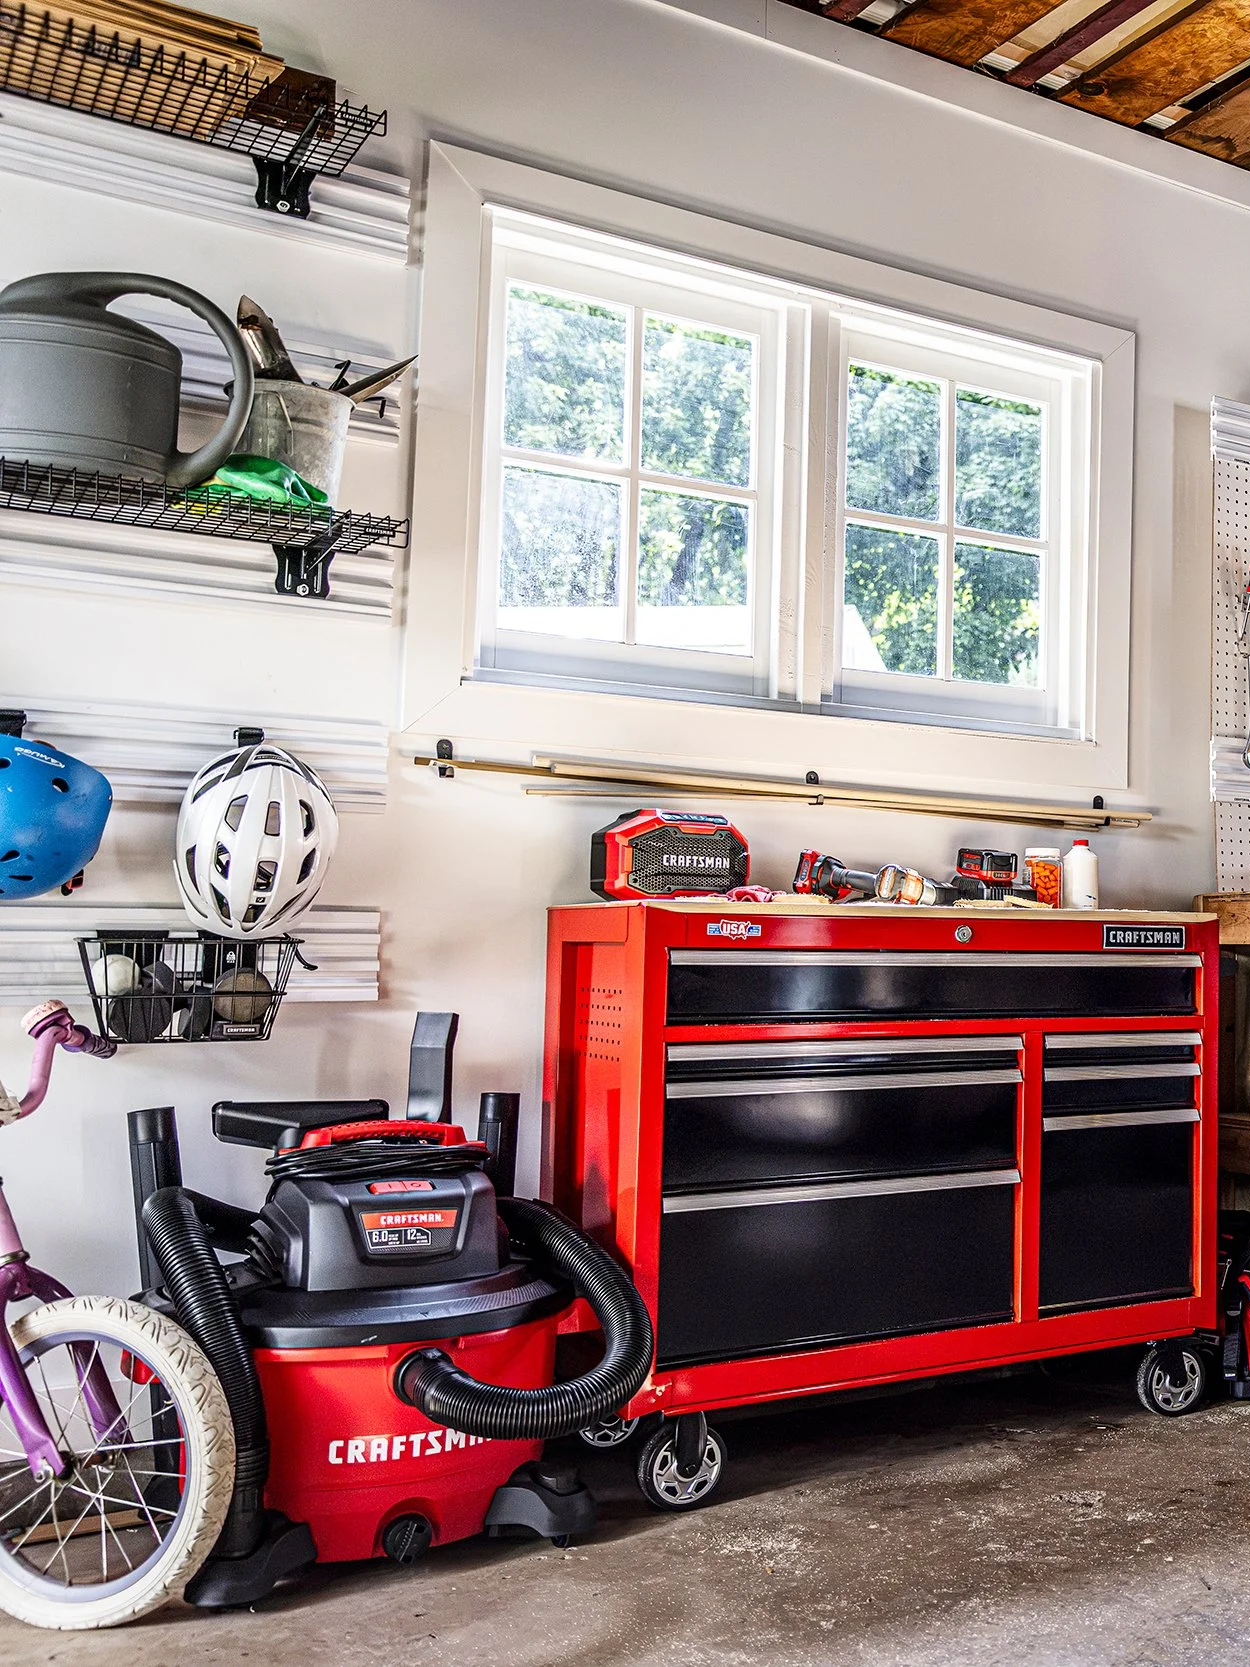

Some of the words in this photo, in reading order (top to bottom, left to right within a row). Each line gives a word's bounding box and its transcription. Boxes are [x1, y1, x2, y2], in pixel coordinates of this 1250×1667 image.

[662, 854, 730, 869] CRAFTSMAN
[722, 923, 746, 935] USA
[1109, 930, 1180, 944] CRAFTSMAN
[380, 1213, 442, 1226] CRAFTSMAN
[372, 1230, 389, 1243] 6.0
[406, 1229, 417, 1241] 12
[328, 1428, 492, 1465] CRAFTSM
